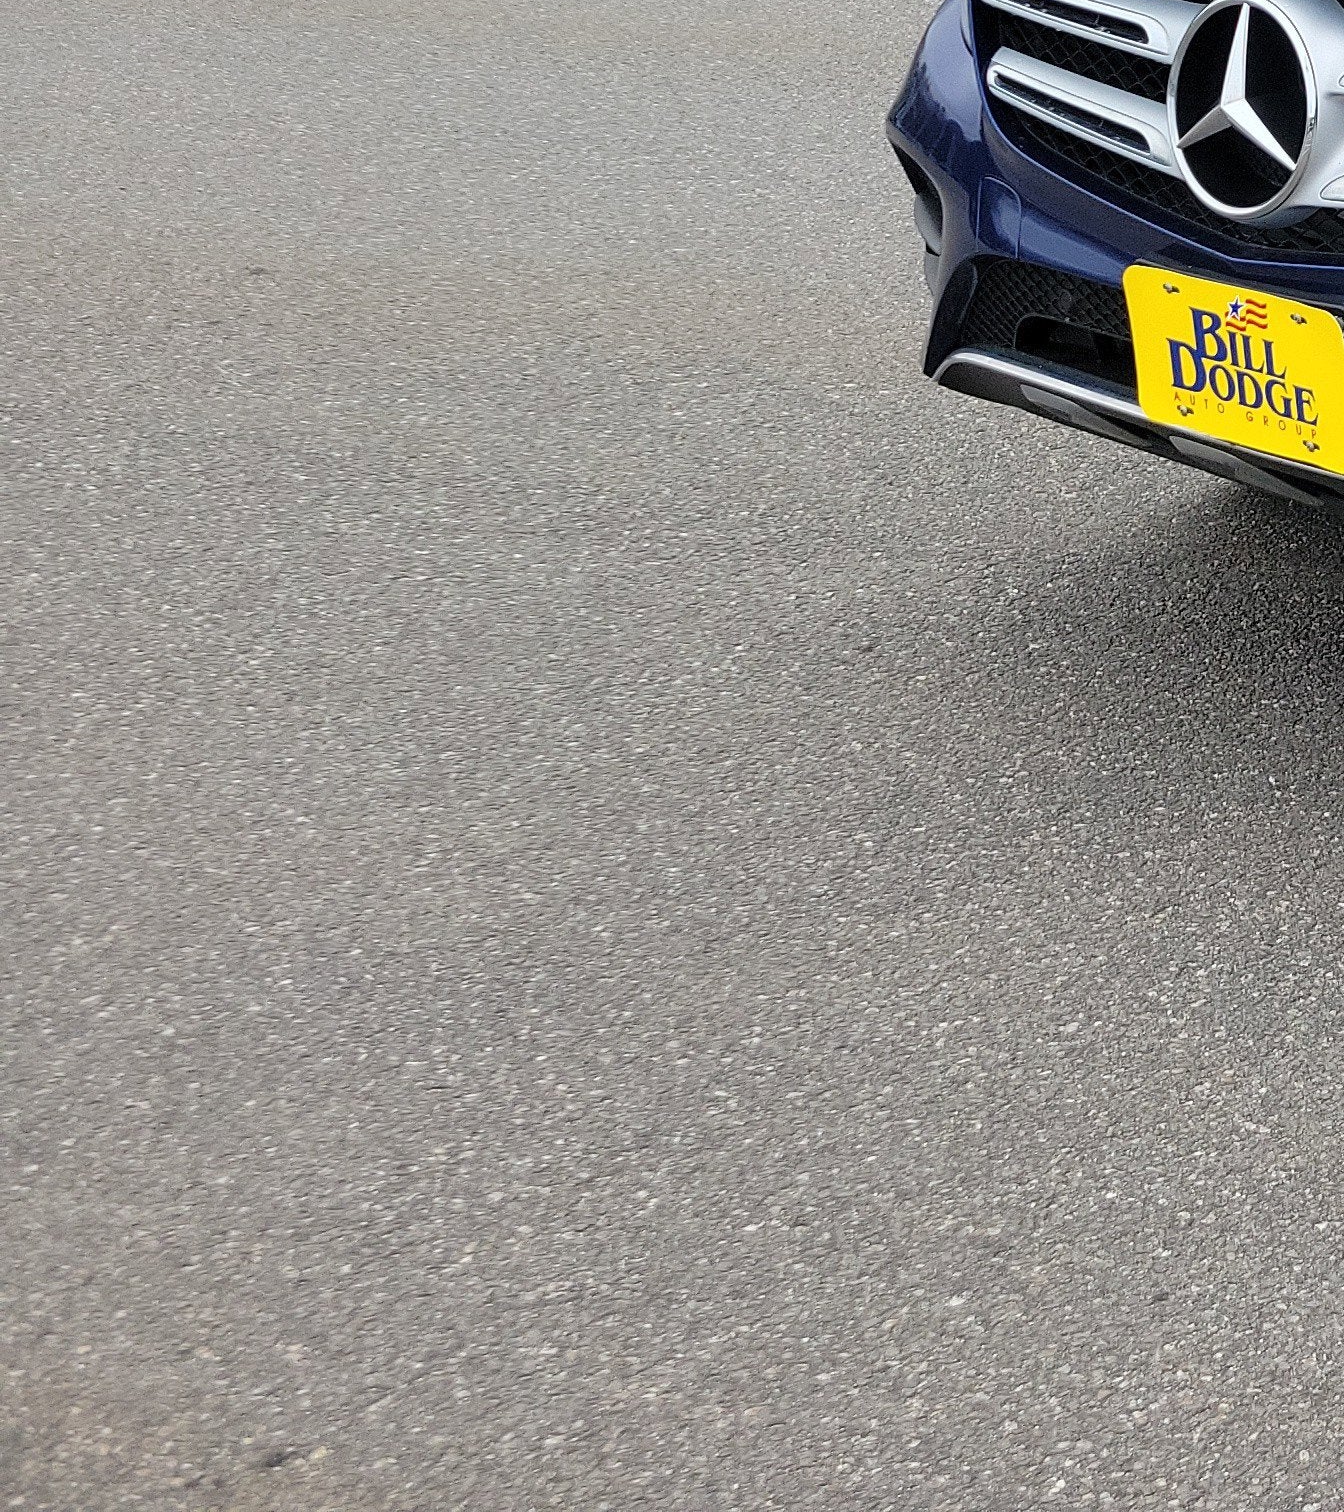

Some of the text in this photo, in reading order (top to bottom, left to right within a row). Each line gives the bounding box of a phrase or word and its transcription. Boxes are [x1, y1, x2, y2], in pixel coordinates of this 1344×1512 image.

[1189, 306, 1287, 379] BILL
[1166, 338, 1319, 427] DODGE
[1174, 391, 1318, 439] AUTO GROUP
